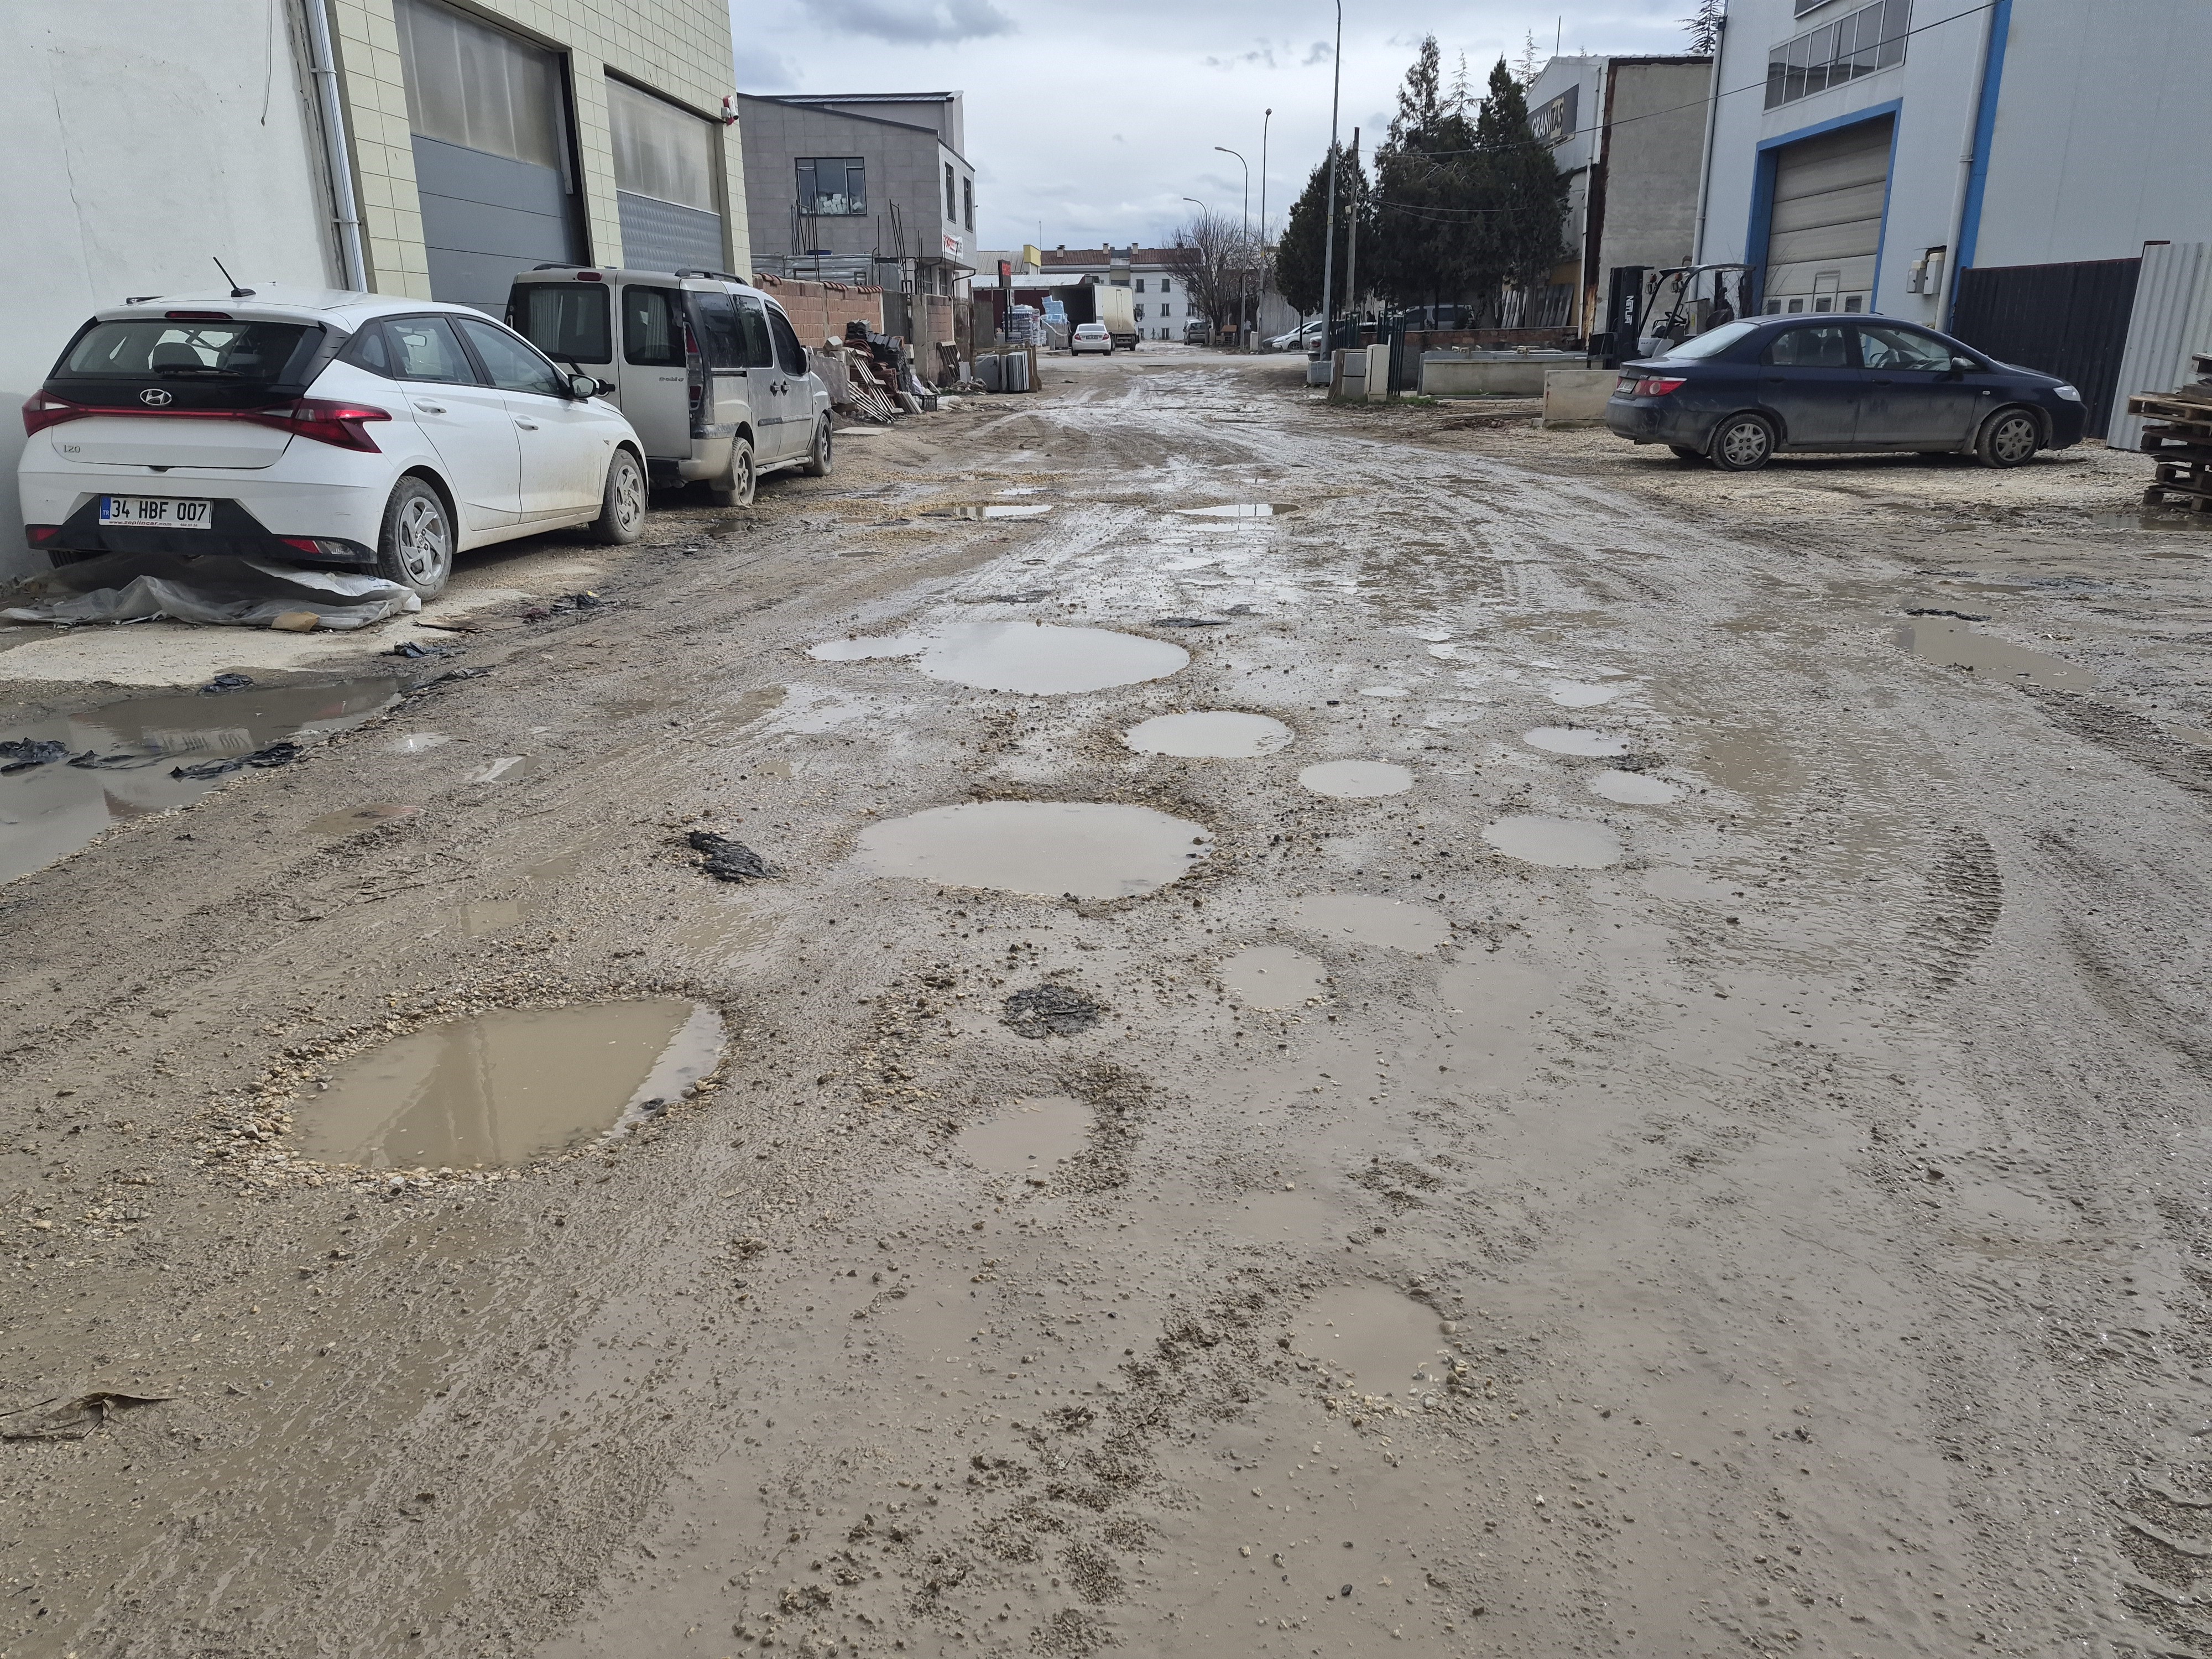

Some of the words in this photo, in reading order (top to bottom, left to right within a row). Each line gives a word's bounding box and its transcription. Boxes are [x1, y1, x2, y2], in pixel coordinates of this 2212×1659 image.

[1625, 295, 1634, 325] NETLIFT
[112, 500, 130, 518] 34
[138, 500, 169, 519] HBF
[177, 502, 207, 521] 007
